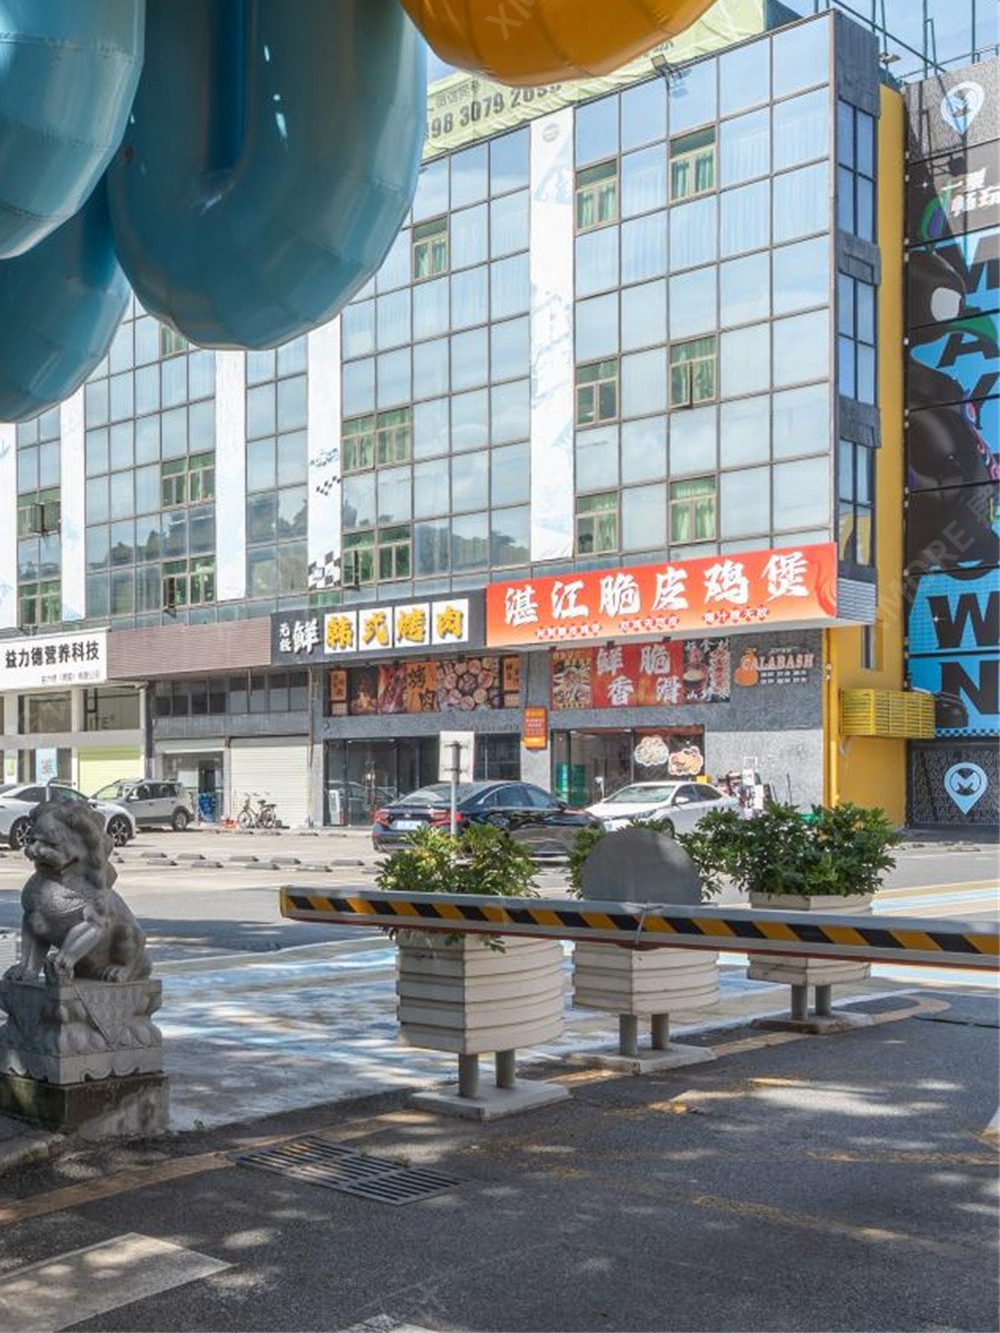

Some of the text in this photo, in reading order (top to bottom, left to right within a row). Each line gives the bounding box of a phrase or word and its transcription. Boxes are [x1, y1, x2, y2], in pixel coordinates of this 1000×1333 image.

[460, 92, 505, 127] 3079
[504, 551, 811, 627] 湛江脆皮鸡煲
[326, 605, 464, 651] 韩式烤肉
[5, 641, 100, 669] 益力德营养科技
